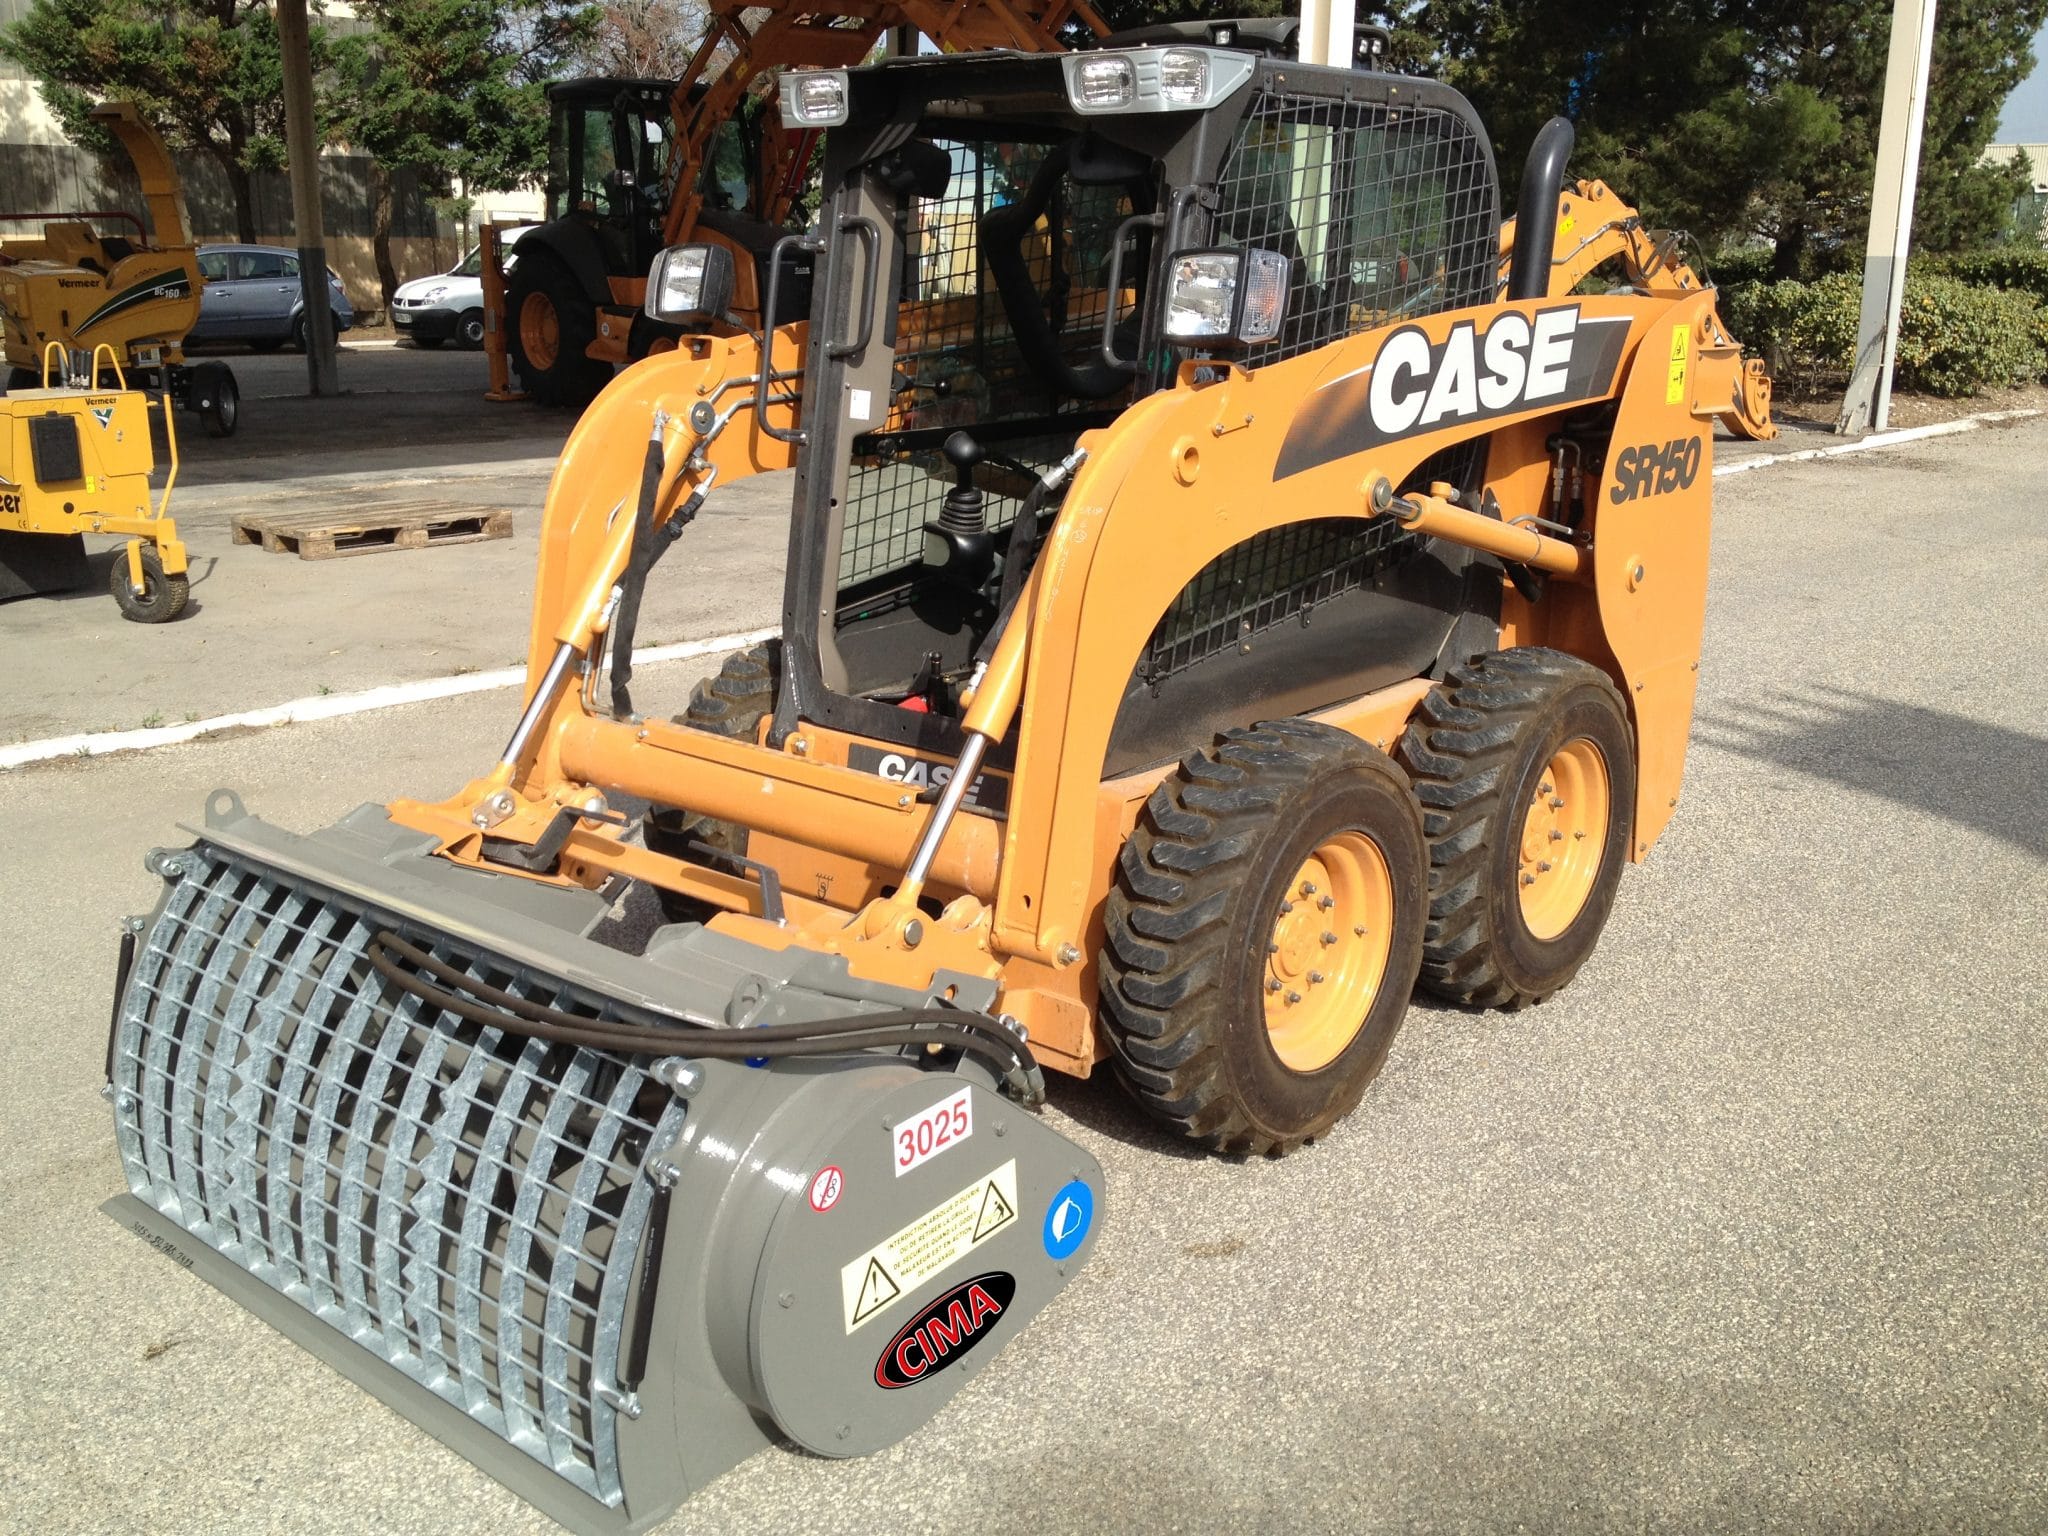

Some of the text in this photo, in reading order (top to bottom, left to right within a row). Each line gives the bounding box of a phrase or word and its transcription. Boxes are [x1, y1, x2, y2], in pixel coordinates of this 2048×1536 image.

[58, 278, 100, 288] Vermeer
[85, 398, 117, 406] Vermeer
[1370, 309, 1579, 434] CASE
[1610, 435, 1702, 506] SR150
[899, 1099, 968, 1167] 3025
[888, 1222, 926, 1249] INTERDICTION
[929, 1204, 953, 1223] ABSOLUE
[896, 1284, 1002, 1378] CIMA
